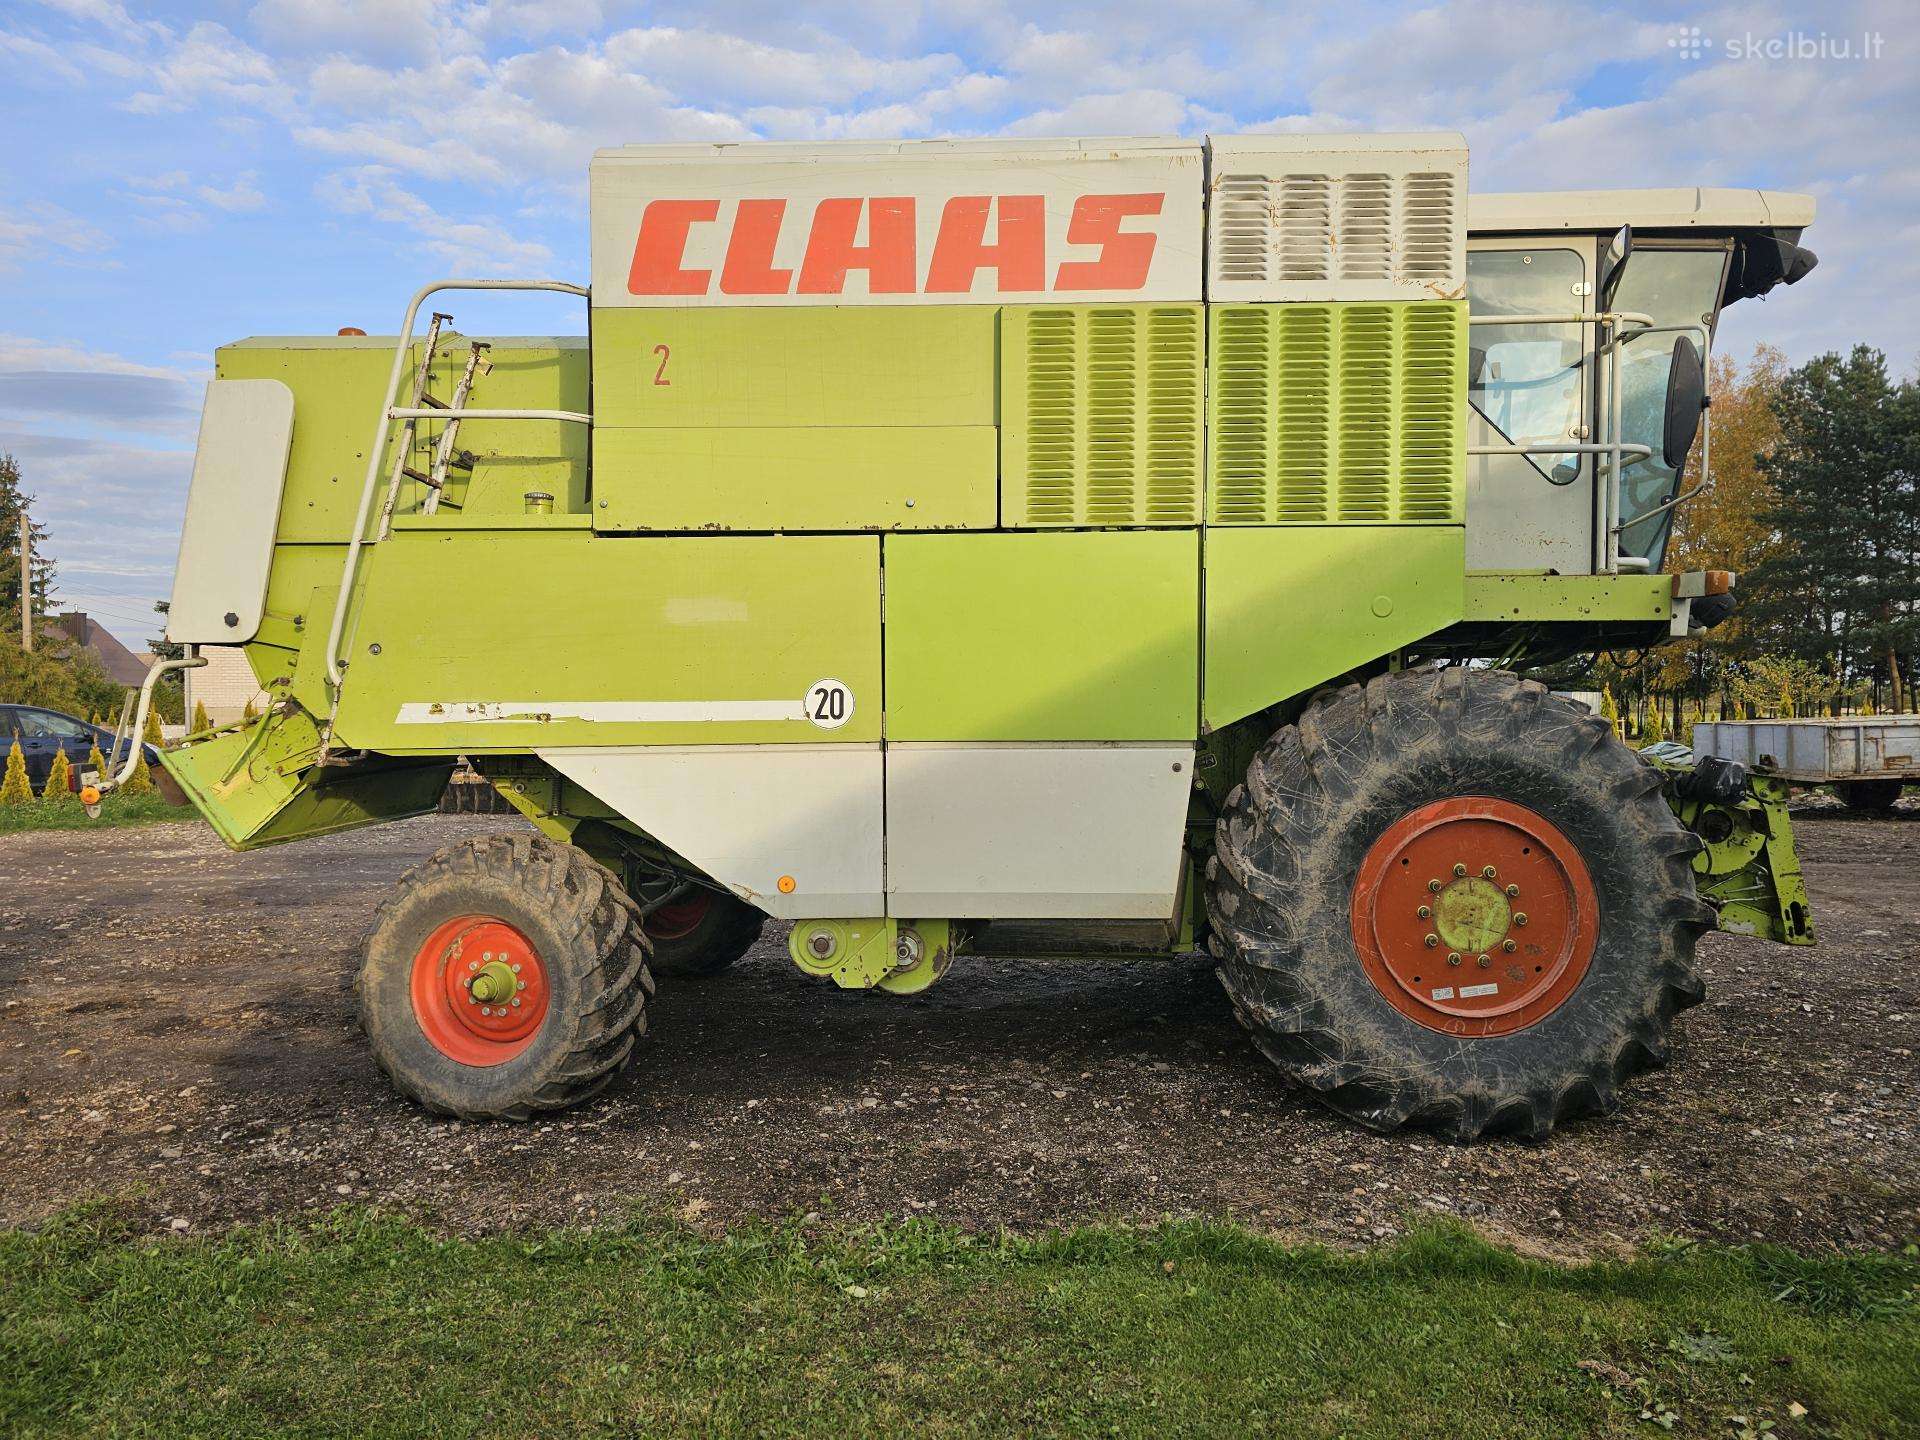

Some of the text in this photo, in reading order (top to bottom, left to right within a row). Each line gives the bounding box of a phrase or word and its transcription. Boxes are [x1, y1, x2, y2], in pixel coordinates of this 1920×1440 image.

[627, 192, 1166, 296] CLAAS
[653, 344, 671, 386] 2
[814, 687, 845, 720] 20
